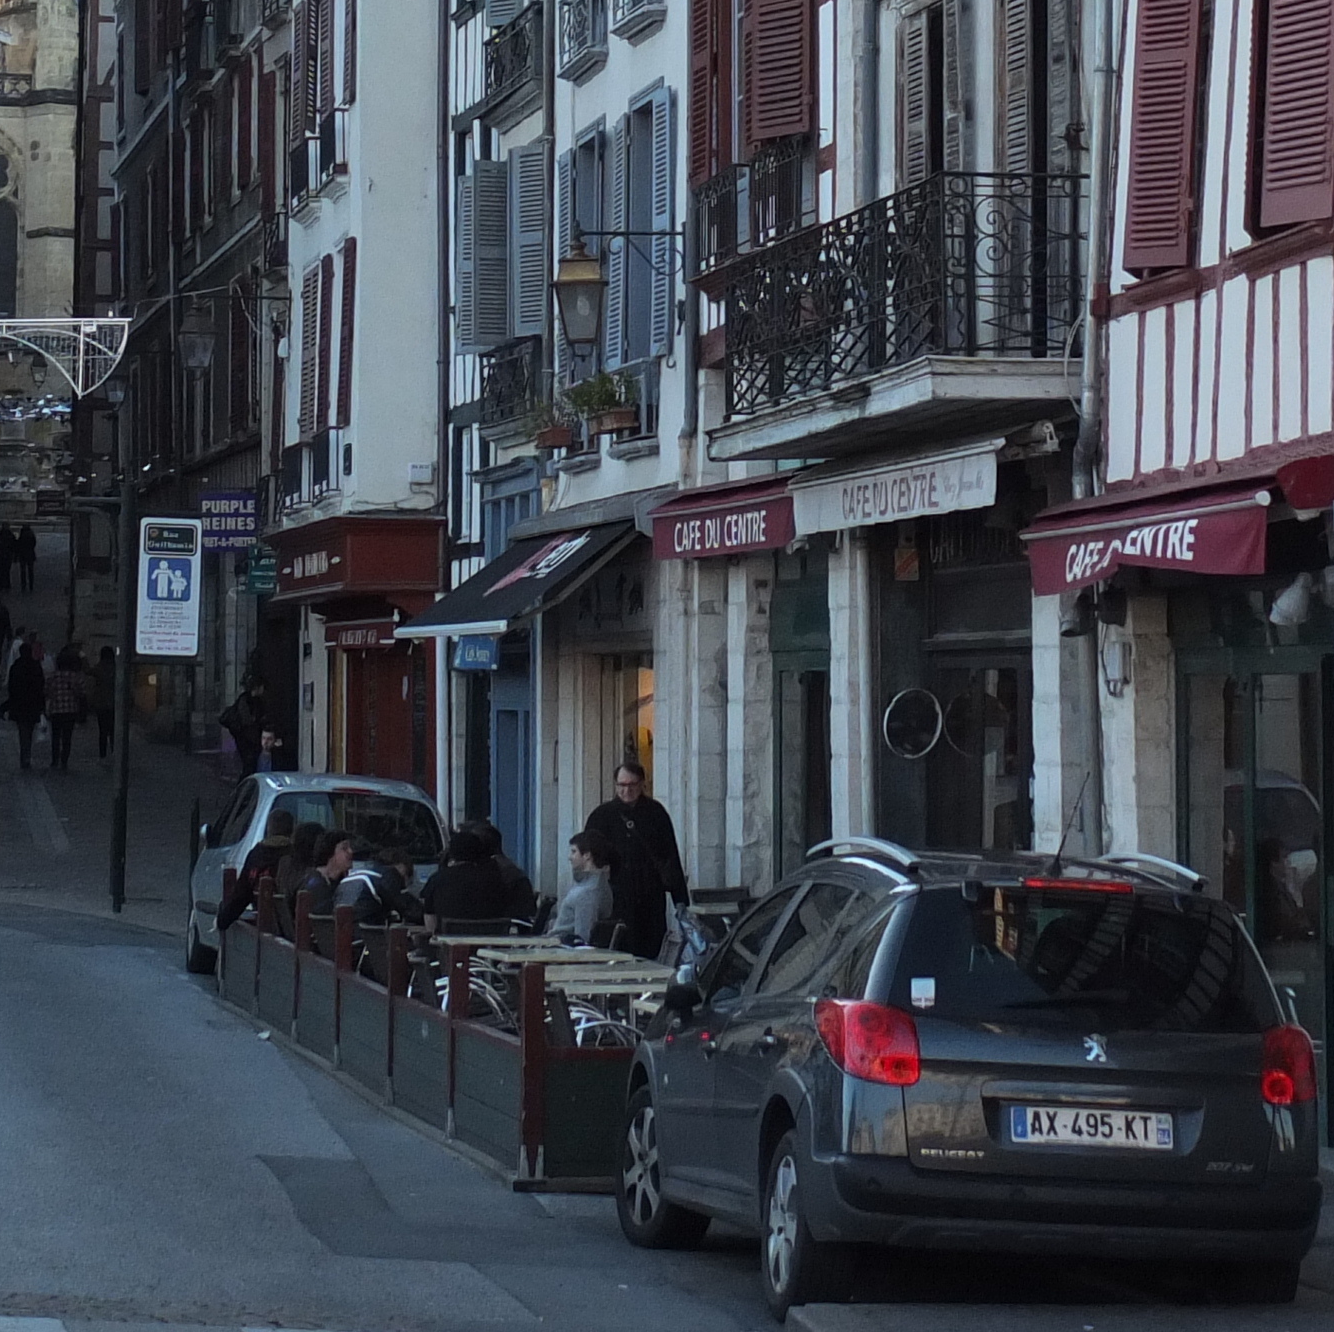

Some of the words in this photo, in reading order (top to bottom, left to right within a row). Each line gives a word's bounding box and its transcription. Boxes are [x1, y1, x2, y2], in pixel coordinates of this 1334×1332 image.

[201, 500, 255, 514] PURPLE
[842, 484, 872, 520] CAFE
[890, 472, 939, 514] CENTRE
[674, 522, 701, 553] CAFE
[705, 517, 720, 548] DU
[724, 510, 766, 546] CENTRE
[1031, 1110, 1152, 1141] AX-495-KT
